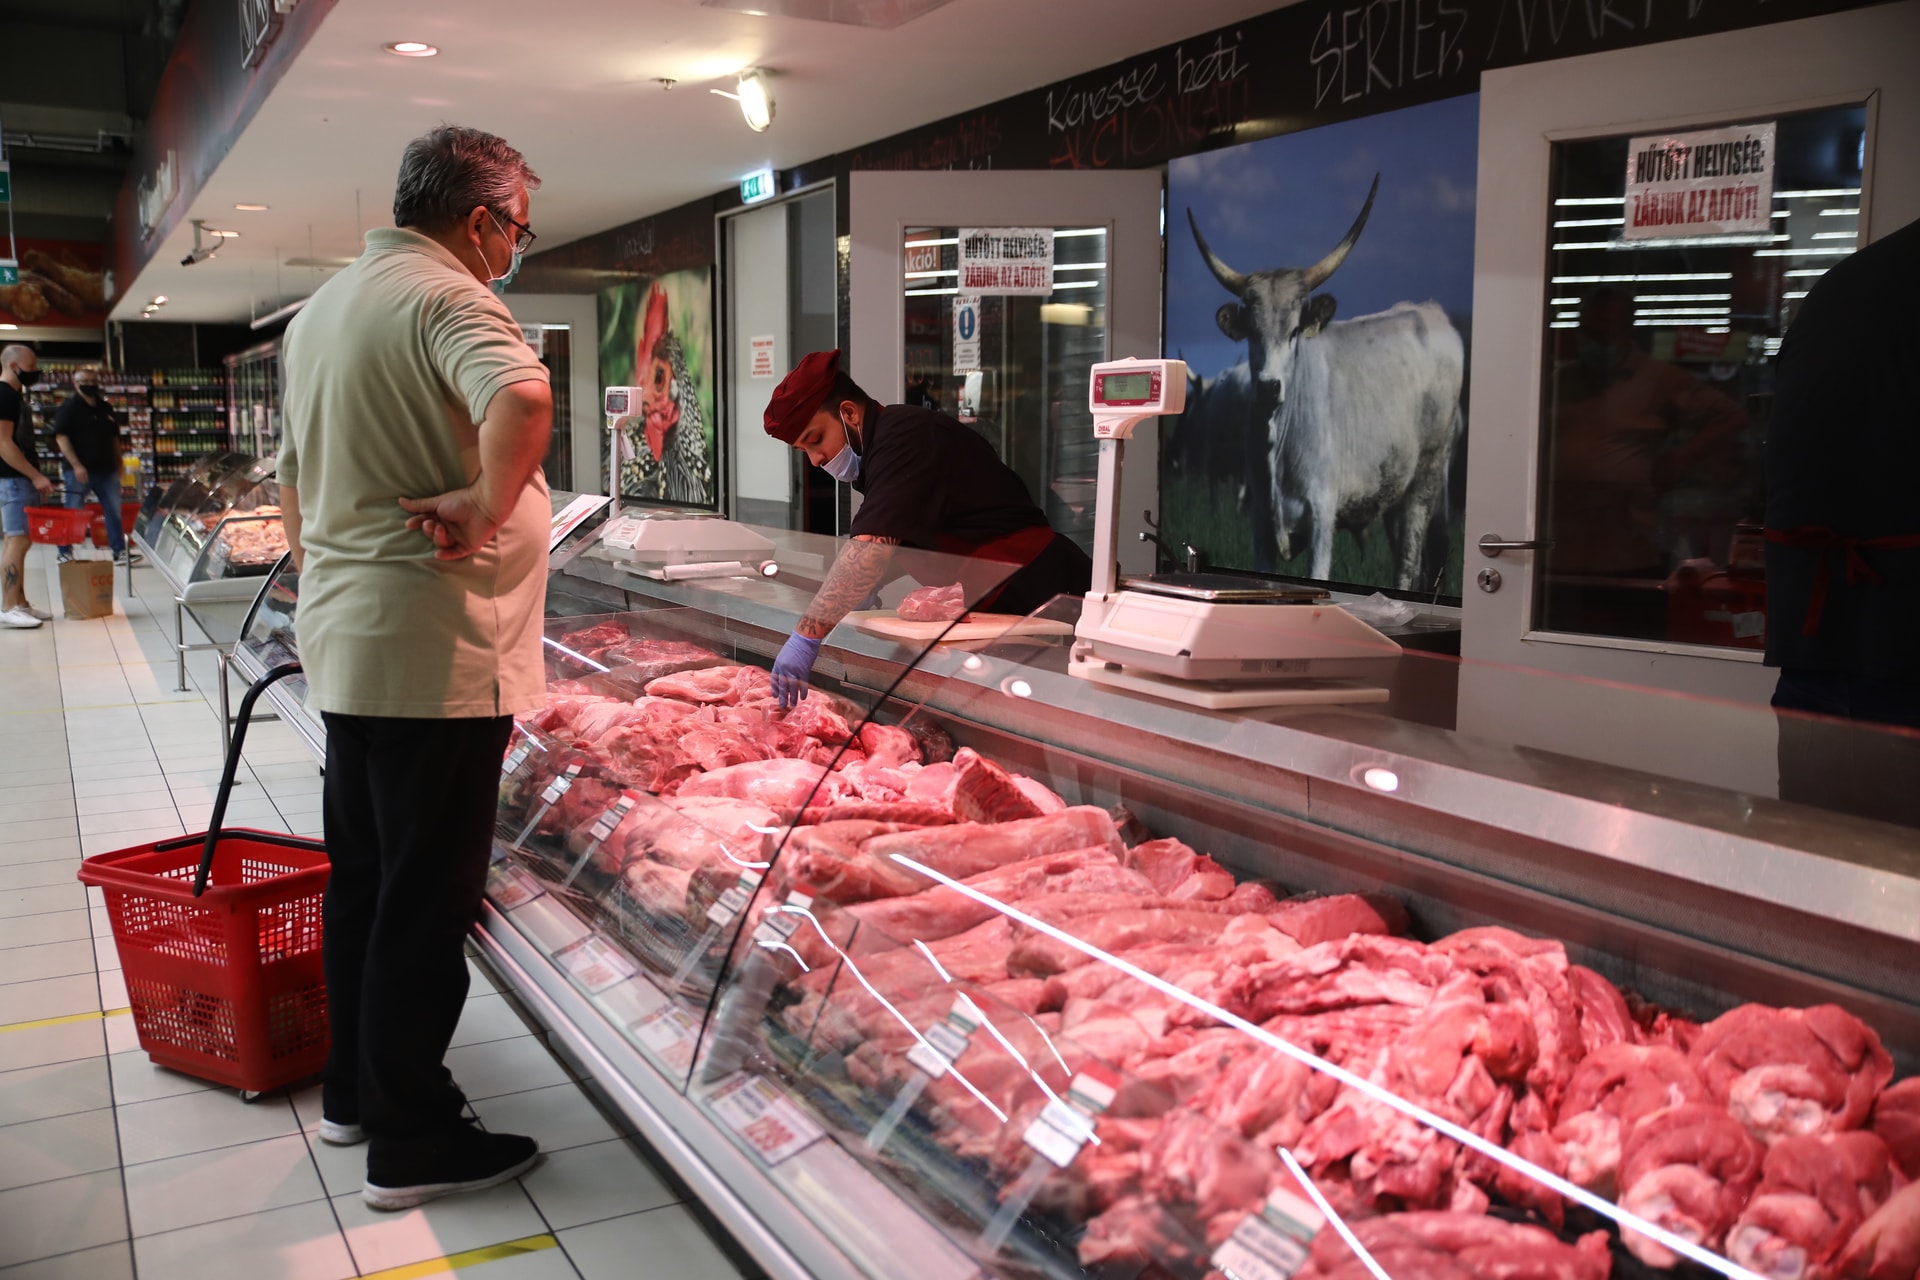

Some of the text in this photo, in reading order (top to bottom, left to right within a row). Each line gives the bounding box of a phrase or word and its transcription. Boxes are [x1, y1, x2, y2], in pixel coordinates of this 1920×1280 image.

[1045, 29, 1251, 136] Keresse heti
[1693, 133, 1766, 179] HELYISÉG:
[1632, 181, 1760, 228] ZÁRJUK AZ AJTÓT!
[964, 262, 1046, 288] ZÁRJUK AZ AJTÓT!
